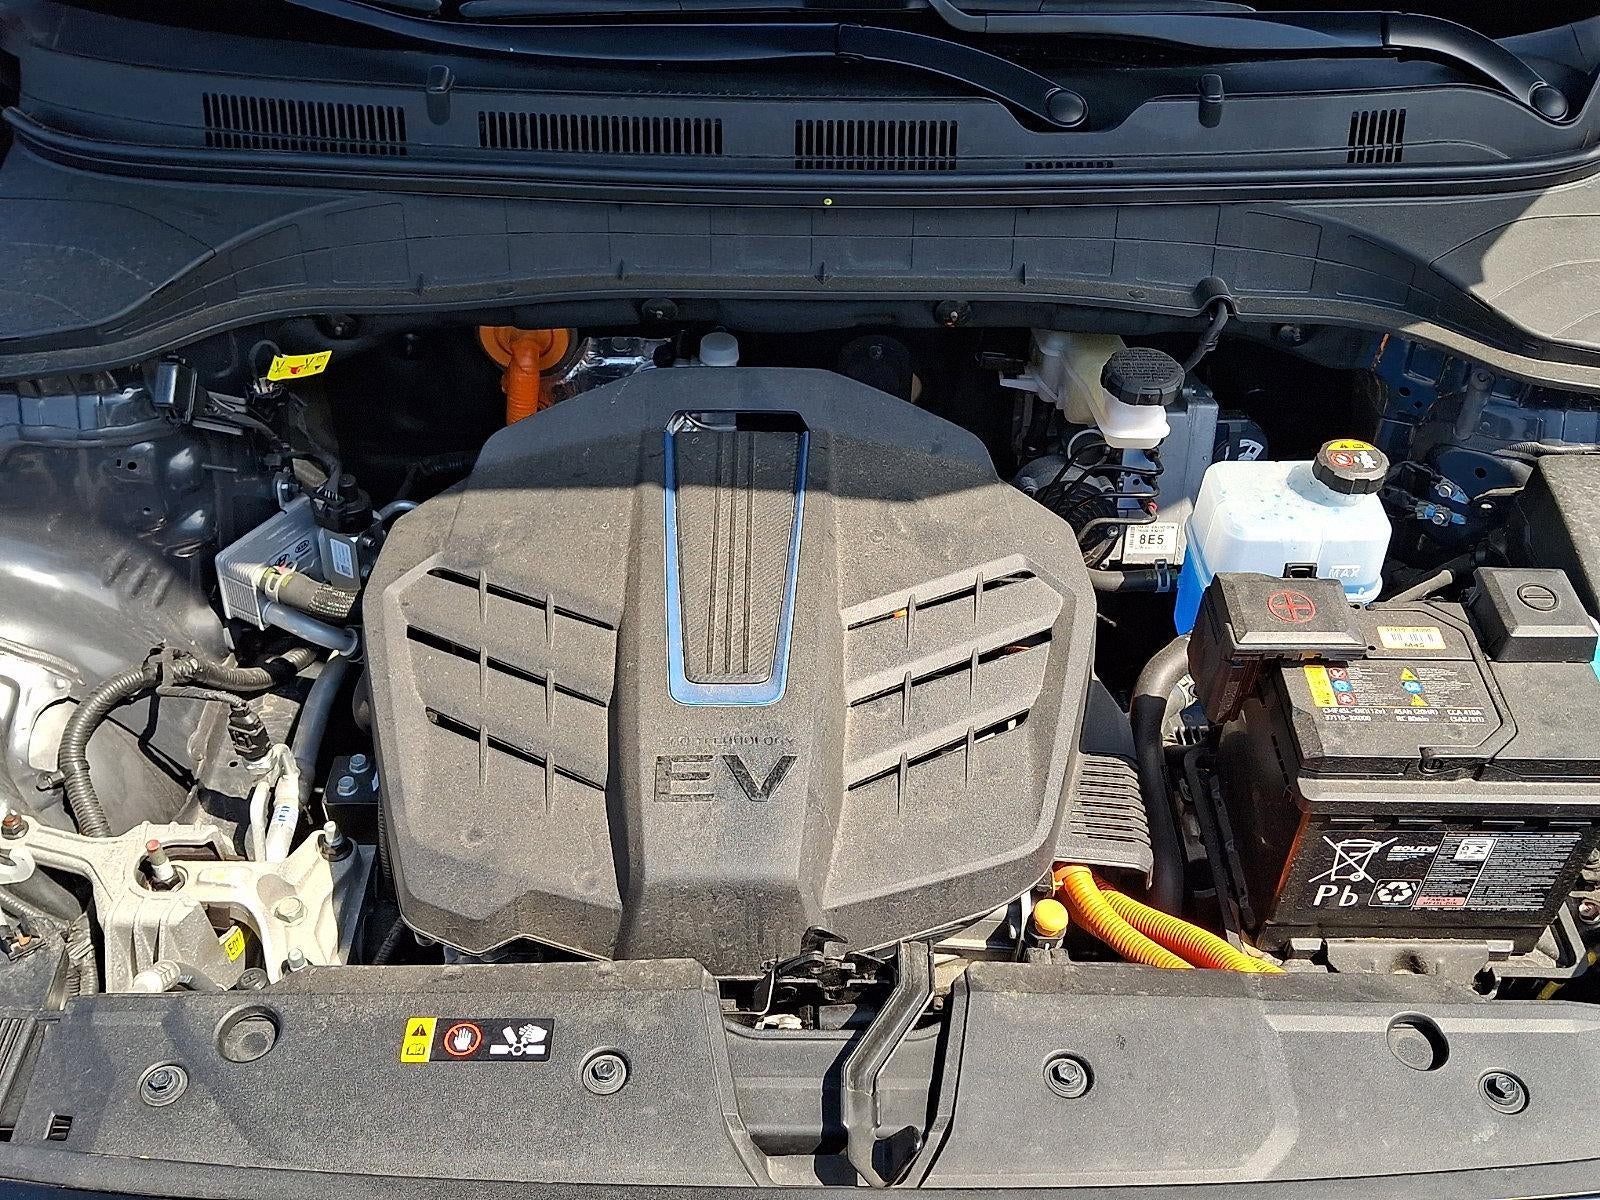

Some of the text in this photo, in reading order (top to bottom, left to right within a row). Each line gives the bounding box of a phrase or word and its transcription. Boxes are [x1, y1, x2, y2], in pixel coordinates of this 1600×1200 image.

[1139, 534, 1164, 545] 8E5
[1329, 567, 1359, 578] MAX
[654, 754, 798, 802] EV
[1312, 884, 1359, 907] Pb
